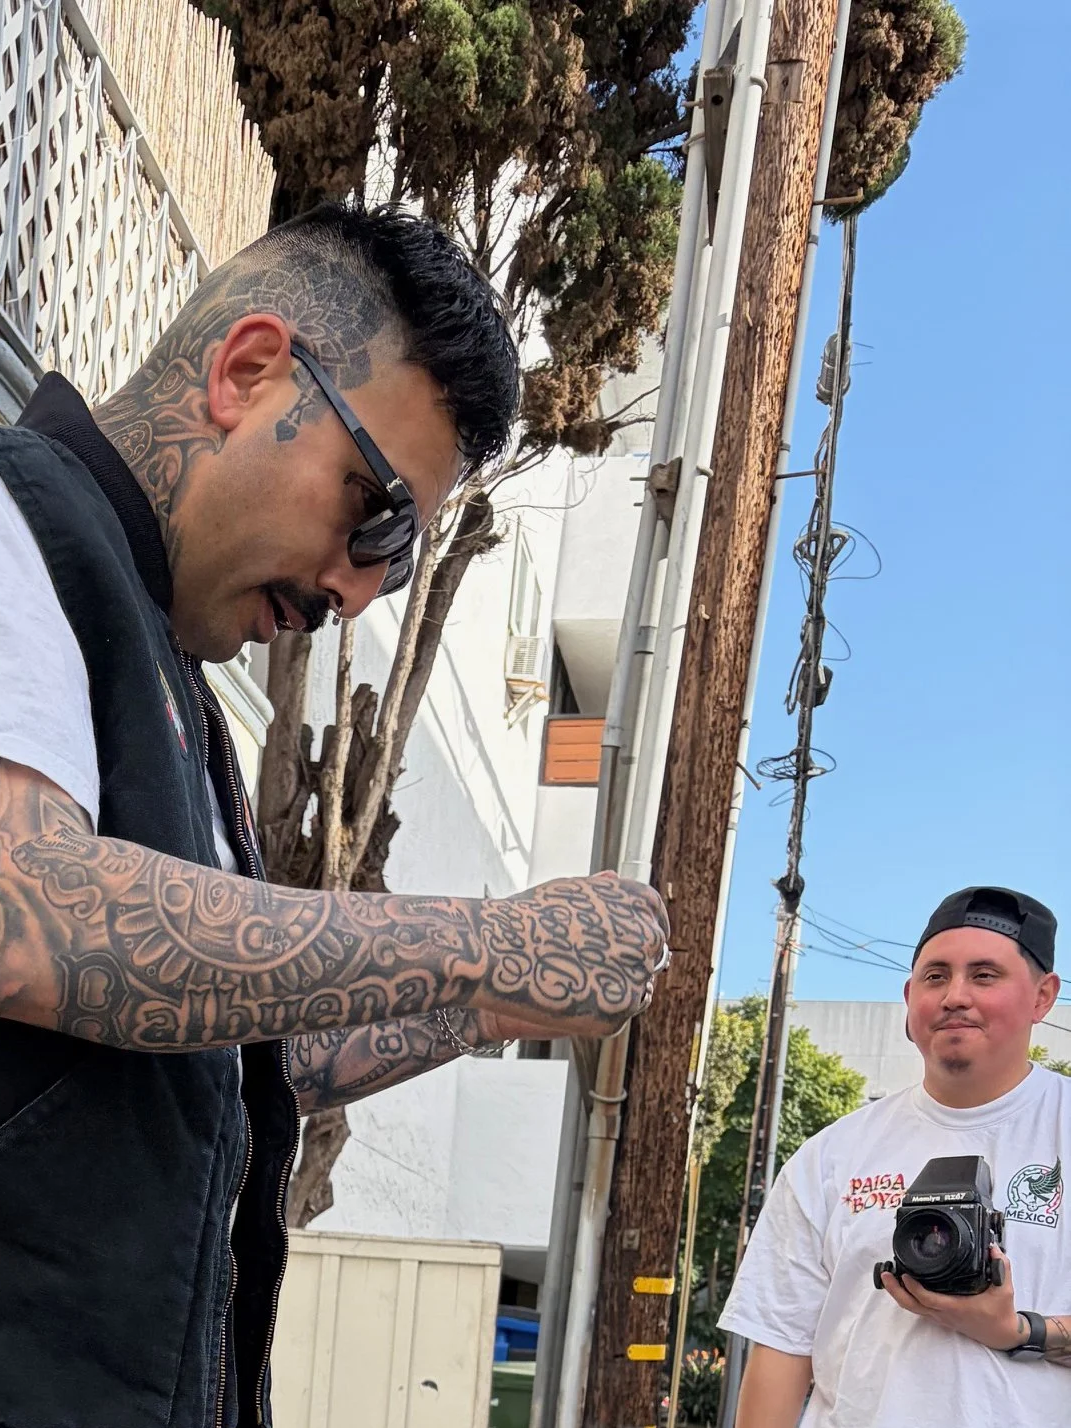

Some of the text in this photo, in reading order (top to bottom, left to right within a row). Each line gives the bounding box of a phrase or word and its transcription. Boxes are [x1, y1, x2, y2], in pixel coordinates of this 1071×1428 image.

[850, 1173, 905, 1195] PAISA
[852, 1192, 902, 1214] BOYS
[1006, 1209, 1055, 1225] MÉXICO
